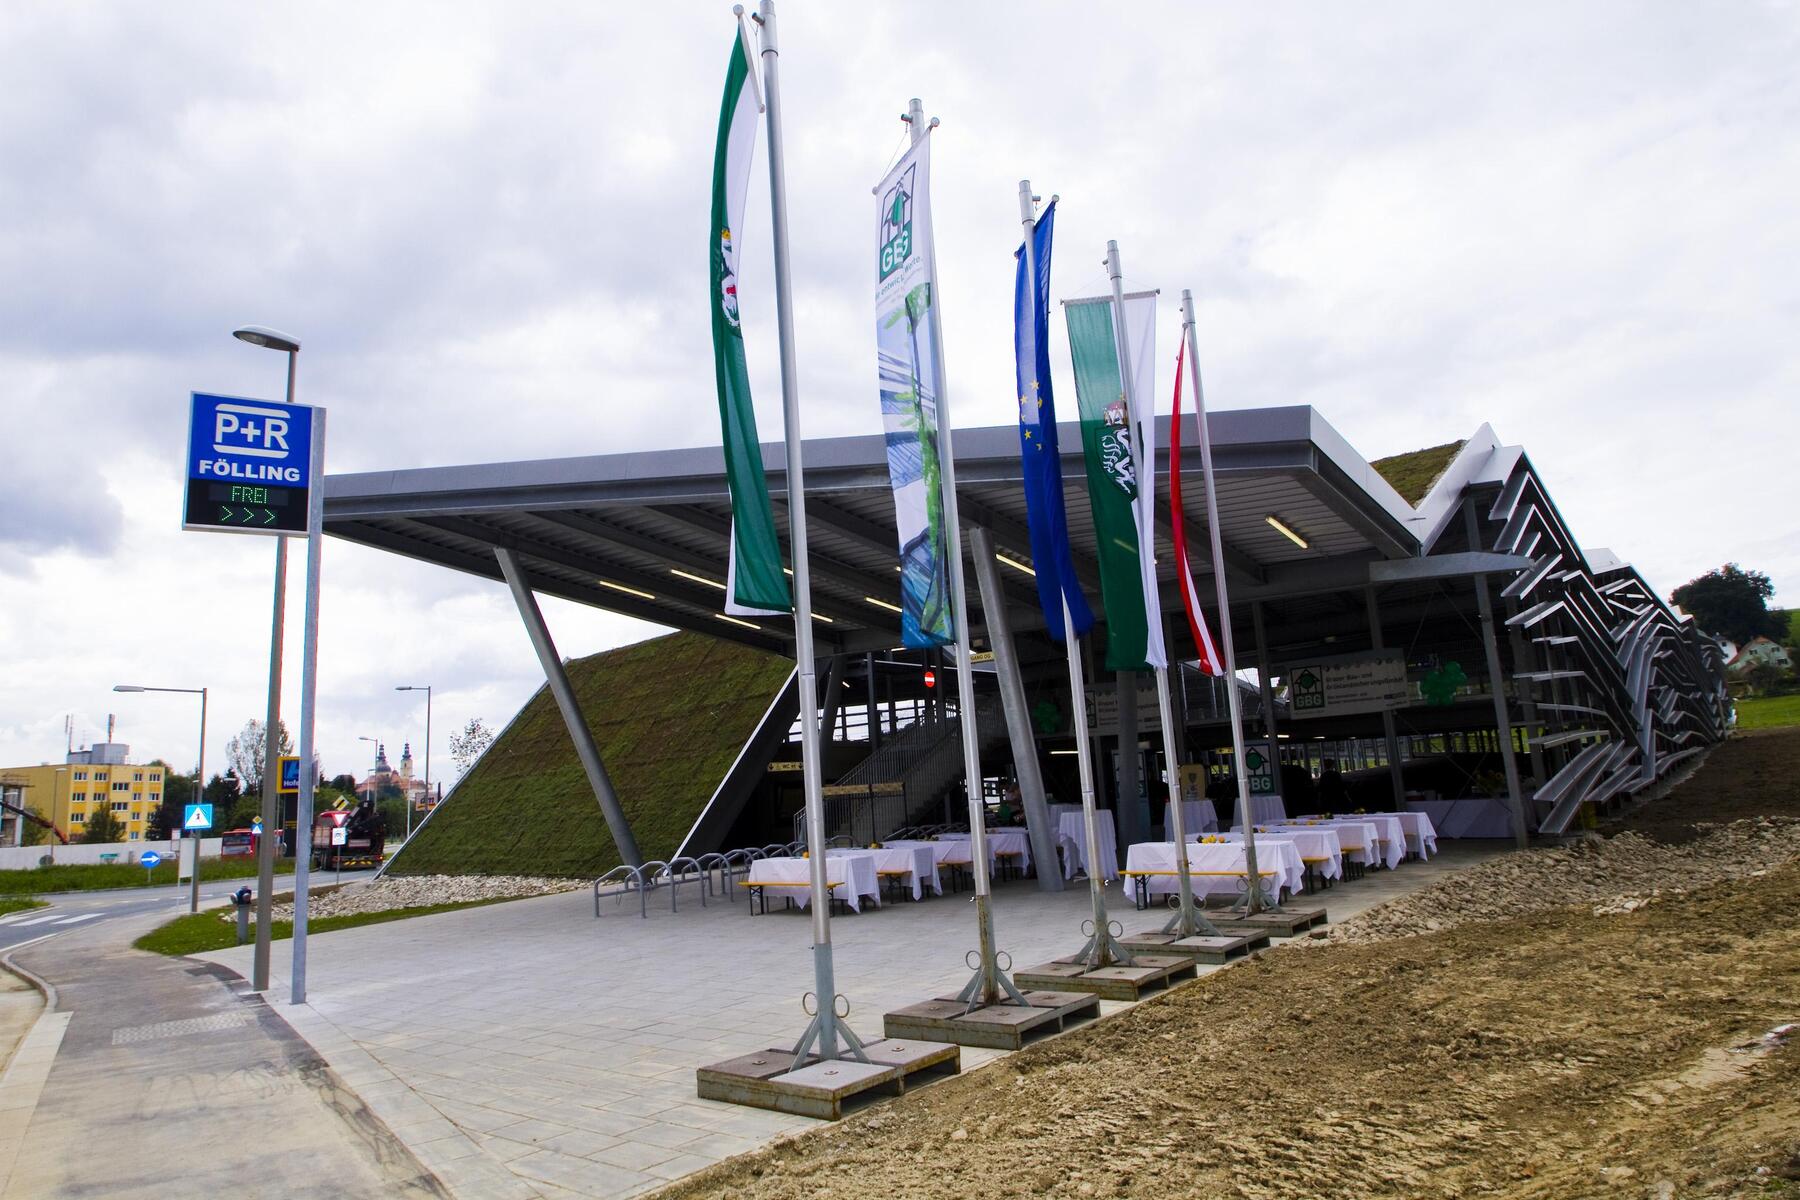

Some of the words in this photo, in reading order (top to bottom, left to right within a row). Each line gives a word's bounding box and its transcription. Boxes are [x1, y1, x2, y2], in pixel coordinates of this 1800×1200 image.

[215, 412, 289, 450] P+R
[199, 458, 300, 482] FÖLLING
[232, 486, 268, 504] FREI
[1296, 694, 1323, 707] GBG
[284, 779, 299, 787] Hofe
[1250, 777, 1271, 790] BG
